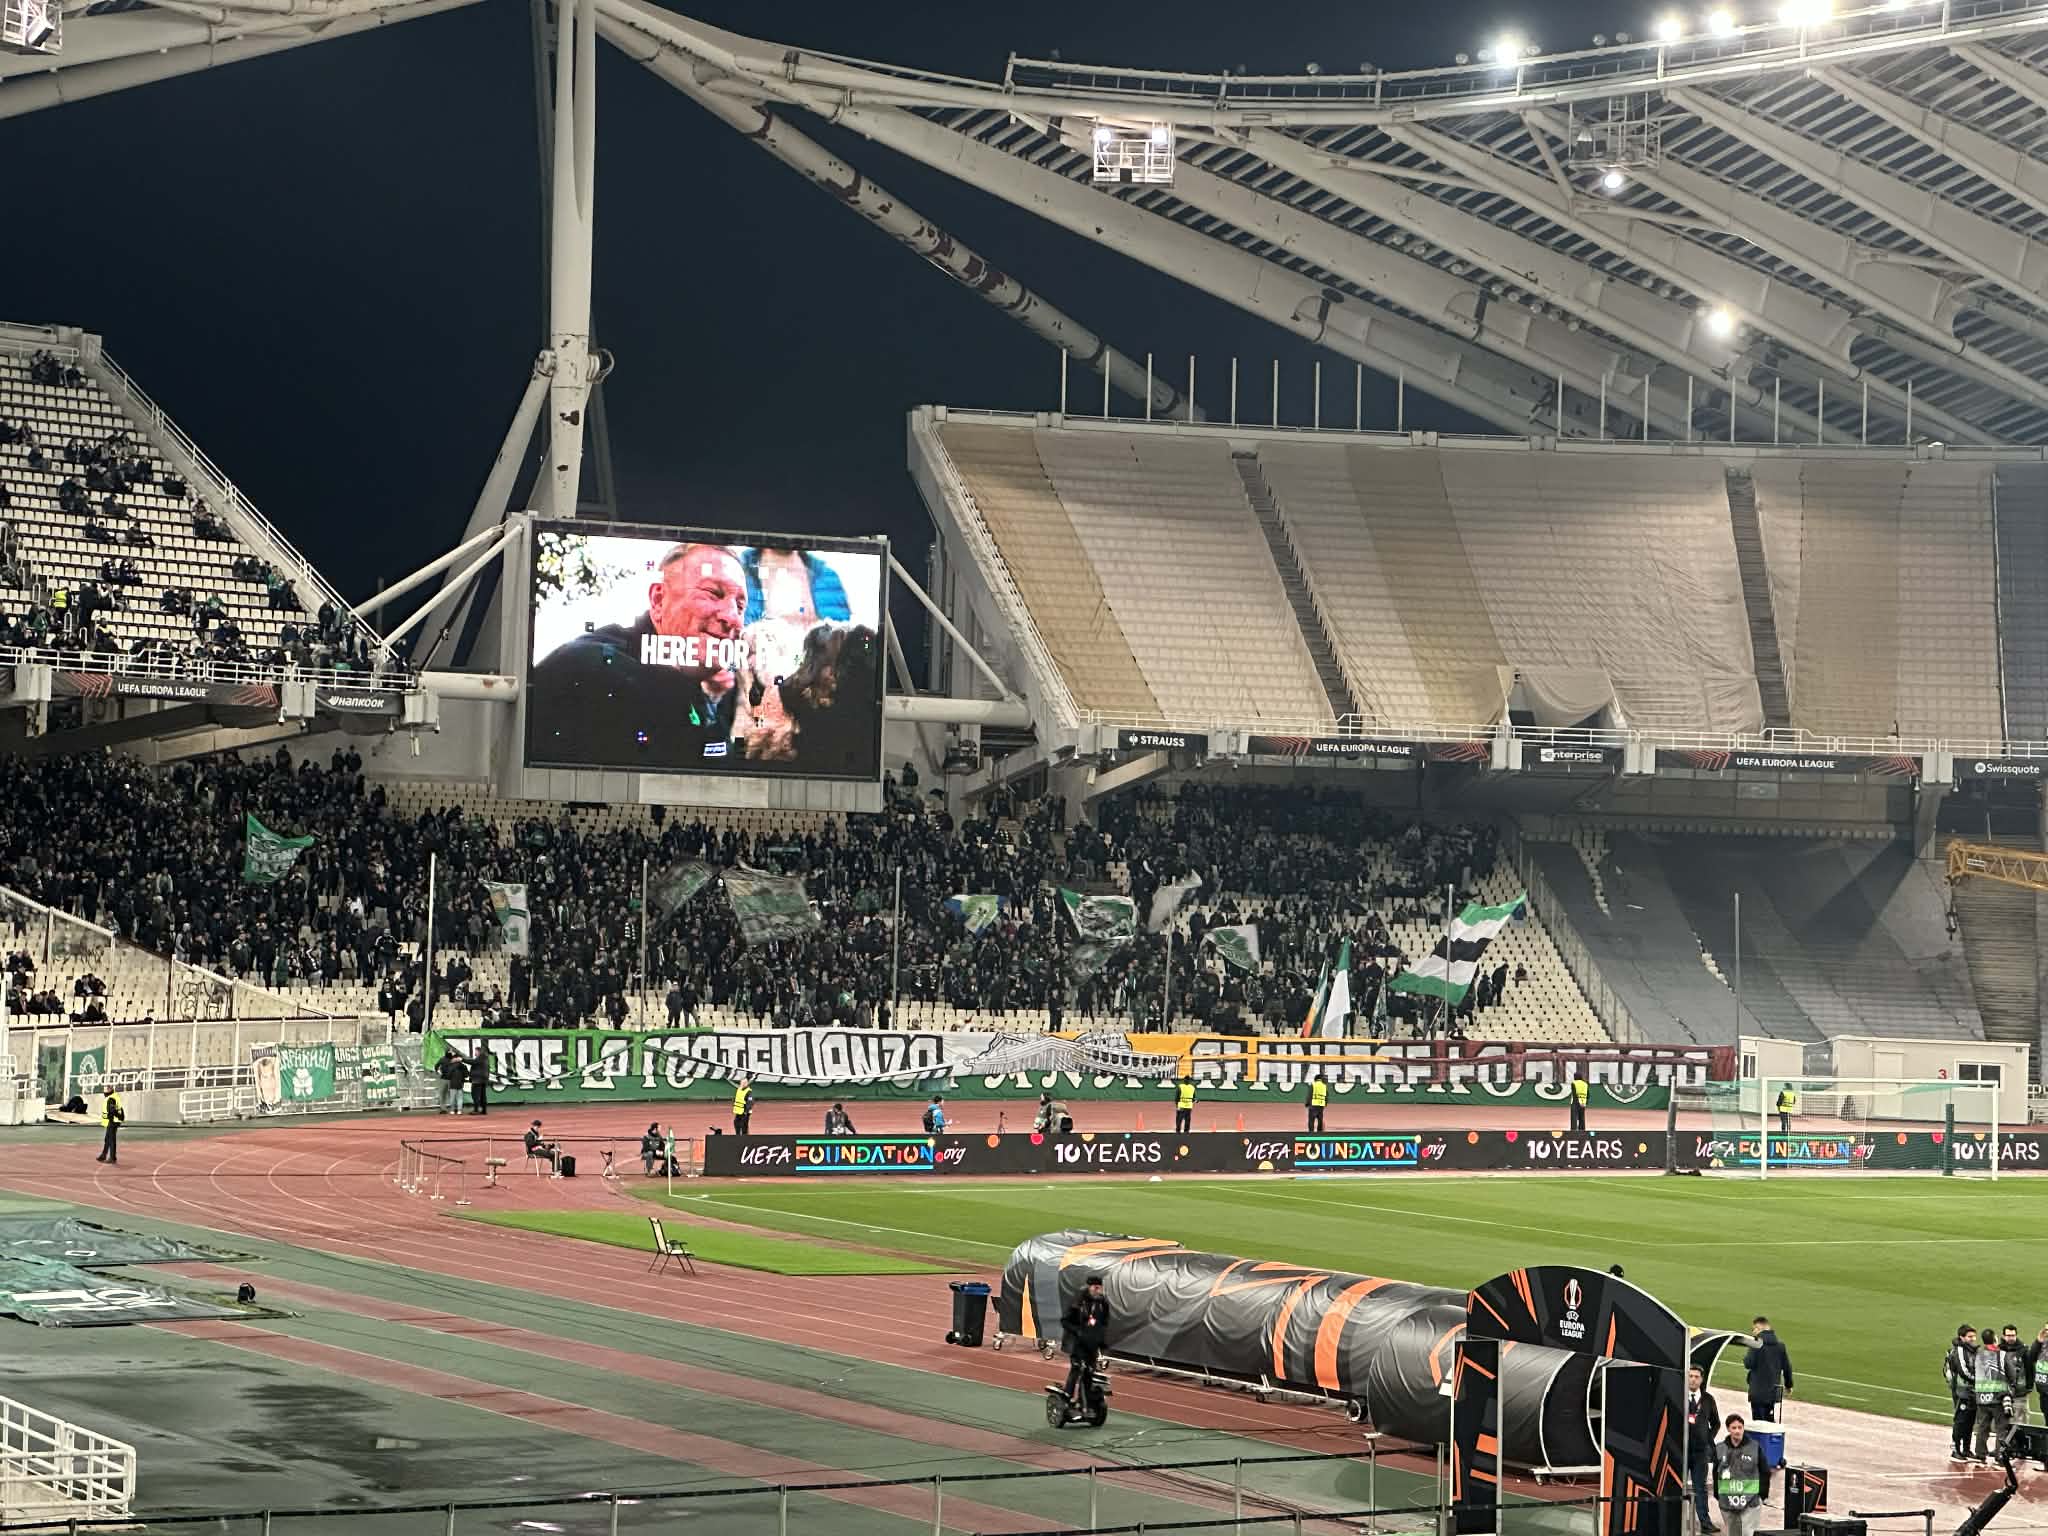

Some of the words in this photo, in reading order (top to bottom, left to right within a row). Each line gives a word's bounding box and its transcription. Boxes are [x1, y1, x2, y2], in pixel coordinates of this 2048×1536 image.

[641, 634, 699, 667] HERE
[705, 638, 749, 671] FOR
[118, 683, 139, 693] UEFA
[141, 685, 173, 695] EUROPA
[175, 687, 206, 696] LEAGUE
[1140, 735, 1185, 747] STRAUSS
[1316, 743, 1339, 752] UEFA
[1341, 744, 1374, 752] EUROPA
[1377, 745, 1411, 754] LEAGUE
[1736, 757, 1760, 766] UEFA
[1762, 758, 1797, 768] EUROPA
[1799, 759, 1834, 768] LEAGUE
[1986, 763, 2040, 775] Swissquote
[741, 1146, 791, 1165] UEFA
[796, 1145, 934, 1164] FOUNDATION
[1054, 1143, 1080, 1163] 10
[1082, 1142, 1161, 1163] YEARS
[1246, 1142, 1290, 1160] UEFA
[1294, 1142, 1418, 1160] FOUNDATION
[1528, 1140, 1551, 1159] 10
[1552, 1139, 1622, 1159] YEARS
[1952, 1143, 1974, 1160] 10
[1560, 1320, 1585, 1332] EUROPA
[1561, 1329, 1583, 1339] LEAGUE
